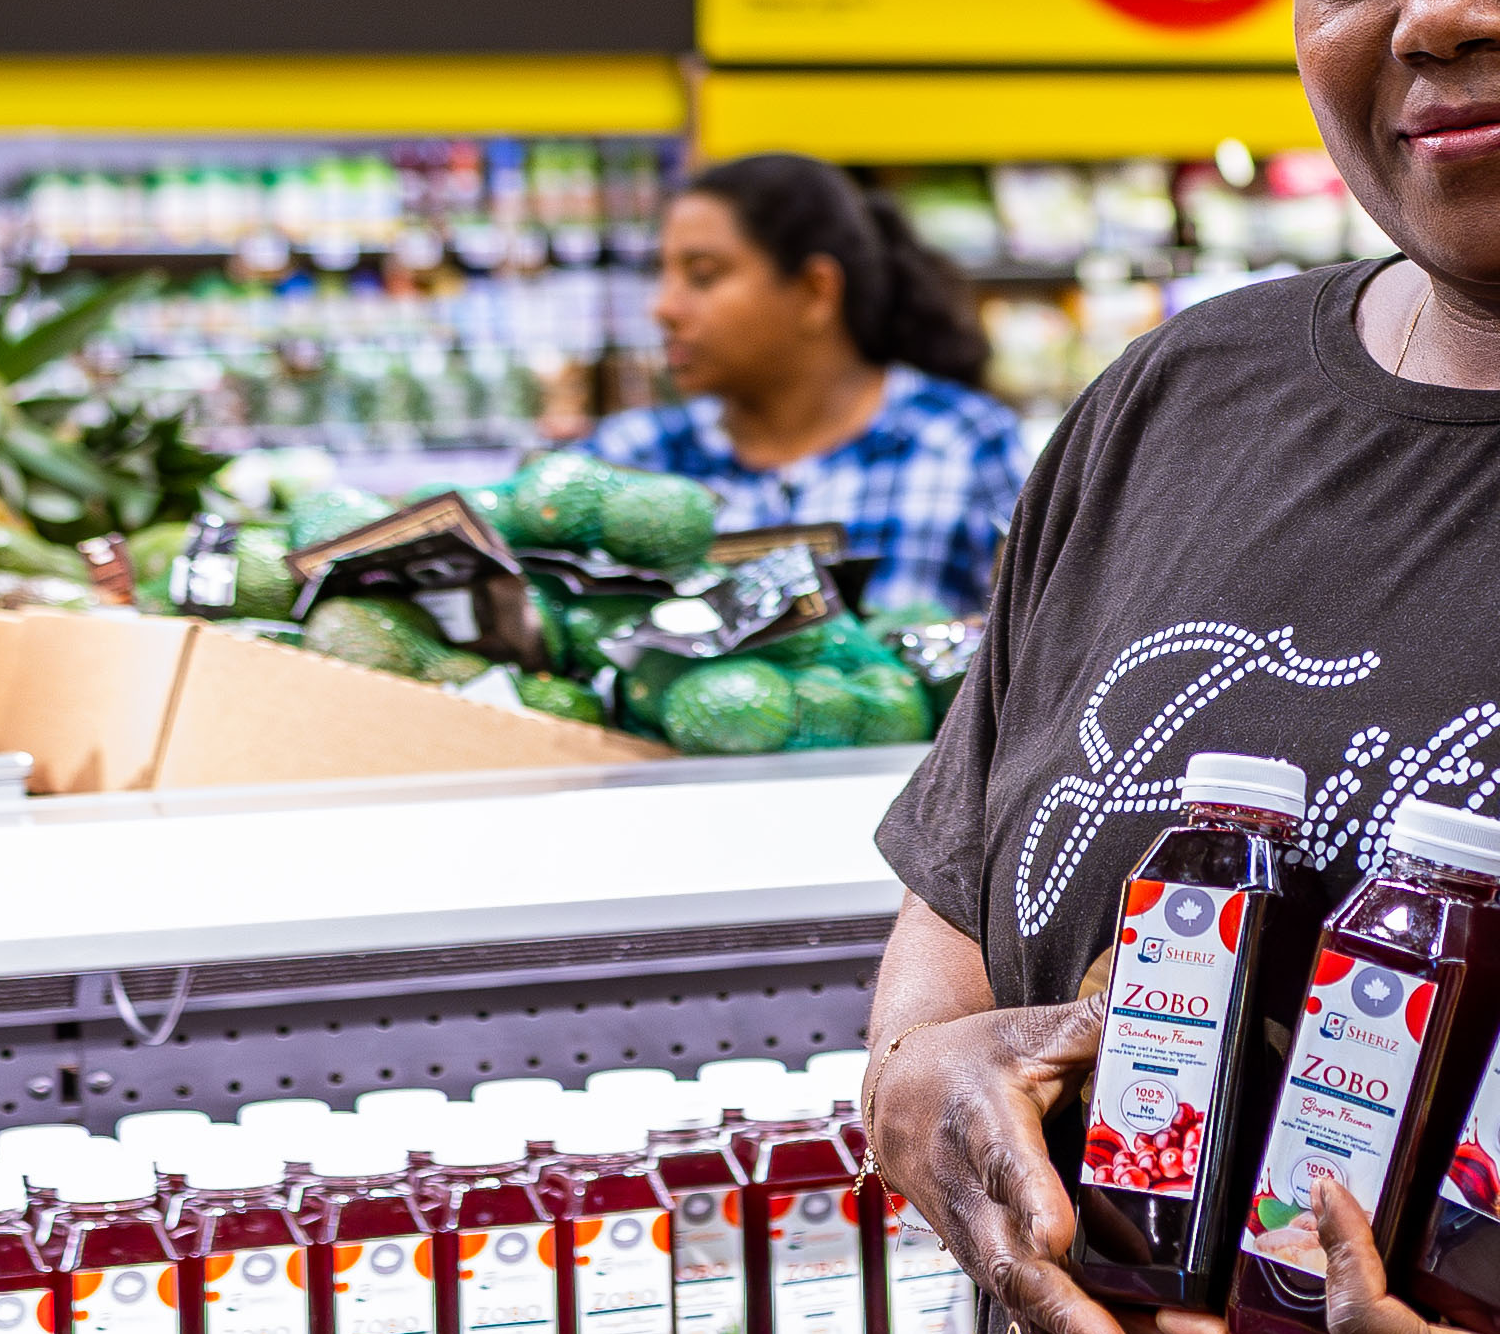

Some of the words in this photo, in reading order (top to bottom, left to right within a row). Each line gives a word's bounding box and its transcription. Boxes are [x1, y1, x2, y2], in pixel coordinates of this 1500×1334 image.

[1166, 947, 1216, 965] SHERIZ
[1122, 983, 1209, 1017] ZOBO
[1346, 1025, 1400, 1053] SHERIZ
[1300, 1054, 1388, 1101] ZOBO
[1135, 1087, 1164, 1100] 100%
[1140, 1105, 1154, 1115] No
[1306, 1162, 1335, 1179] 100%
[678, 1261, 730, 1280] OBO
